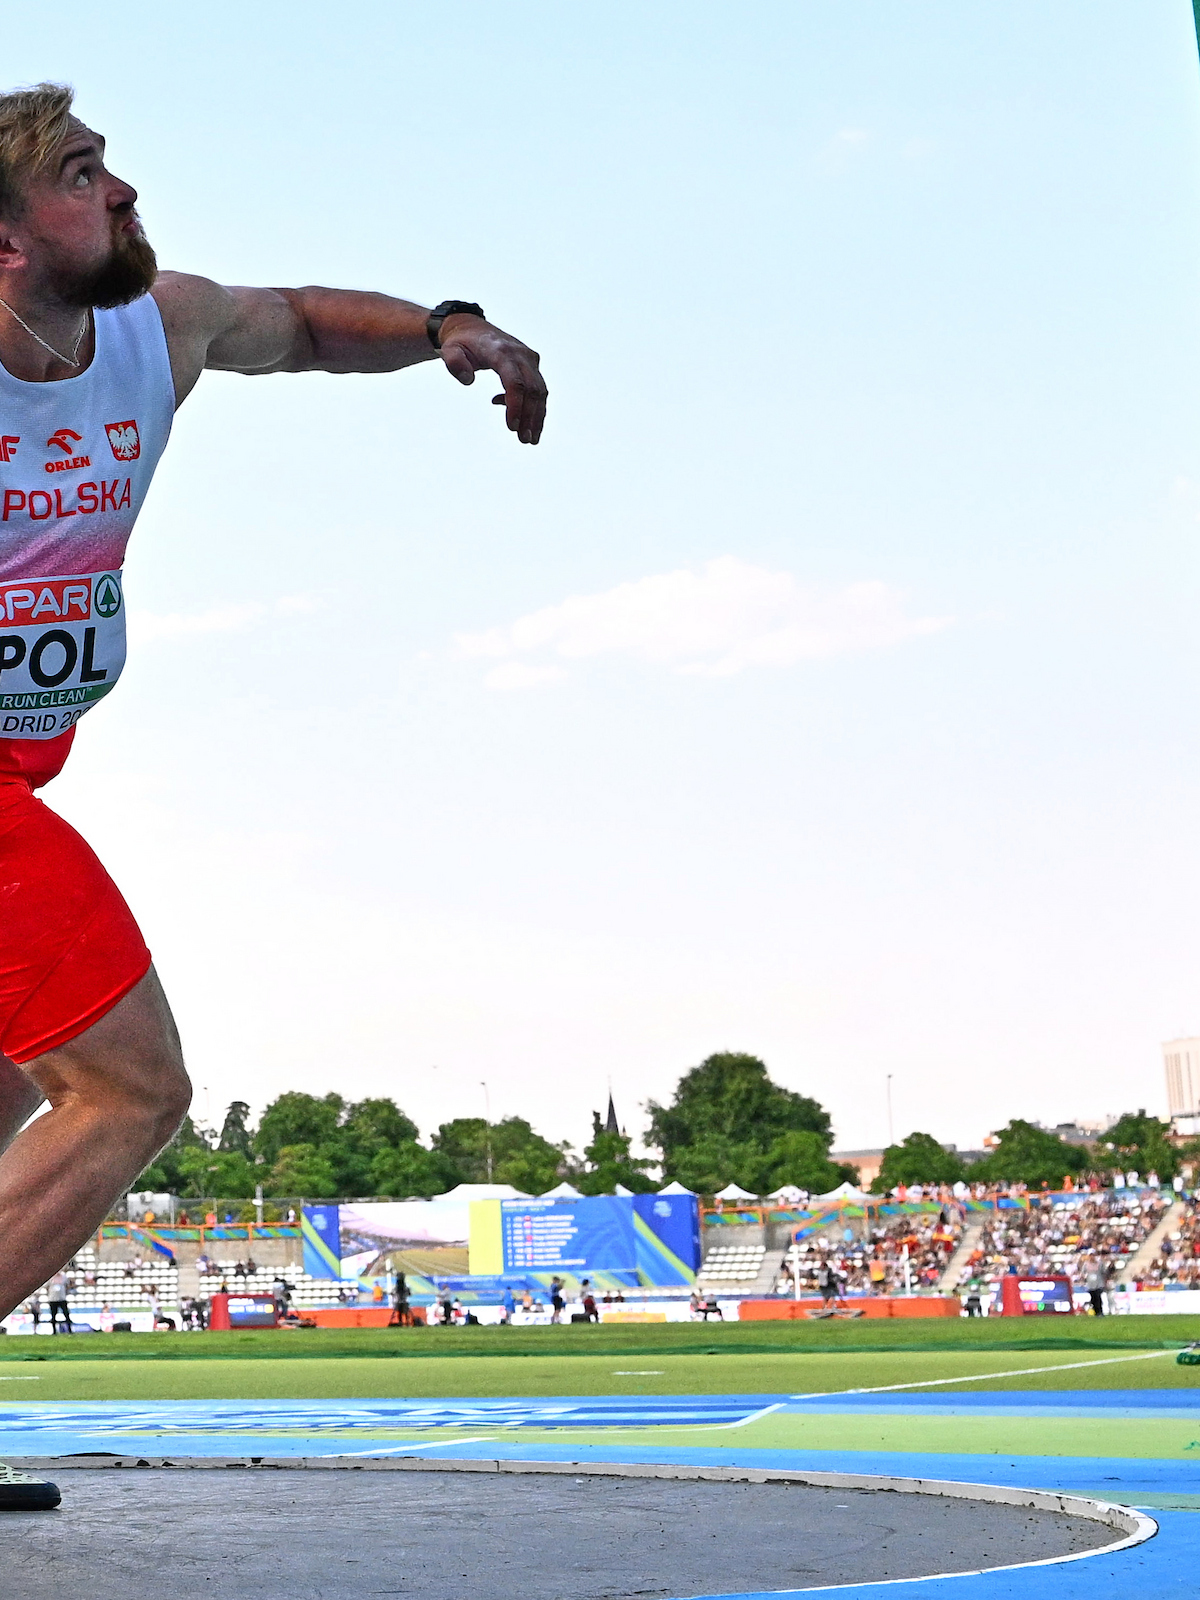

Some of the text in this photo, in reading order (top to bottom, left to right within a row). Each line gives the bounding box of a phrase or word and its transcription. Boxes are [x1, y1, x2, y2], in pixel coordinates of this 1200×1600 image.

[45, 455, 91, 473] ORLEN
[2, 477, 131, 521] POLSKA
[1, 694, 37, 708] RUN
